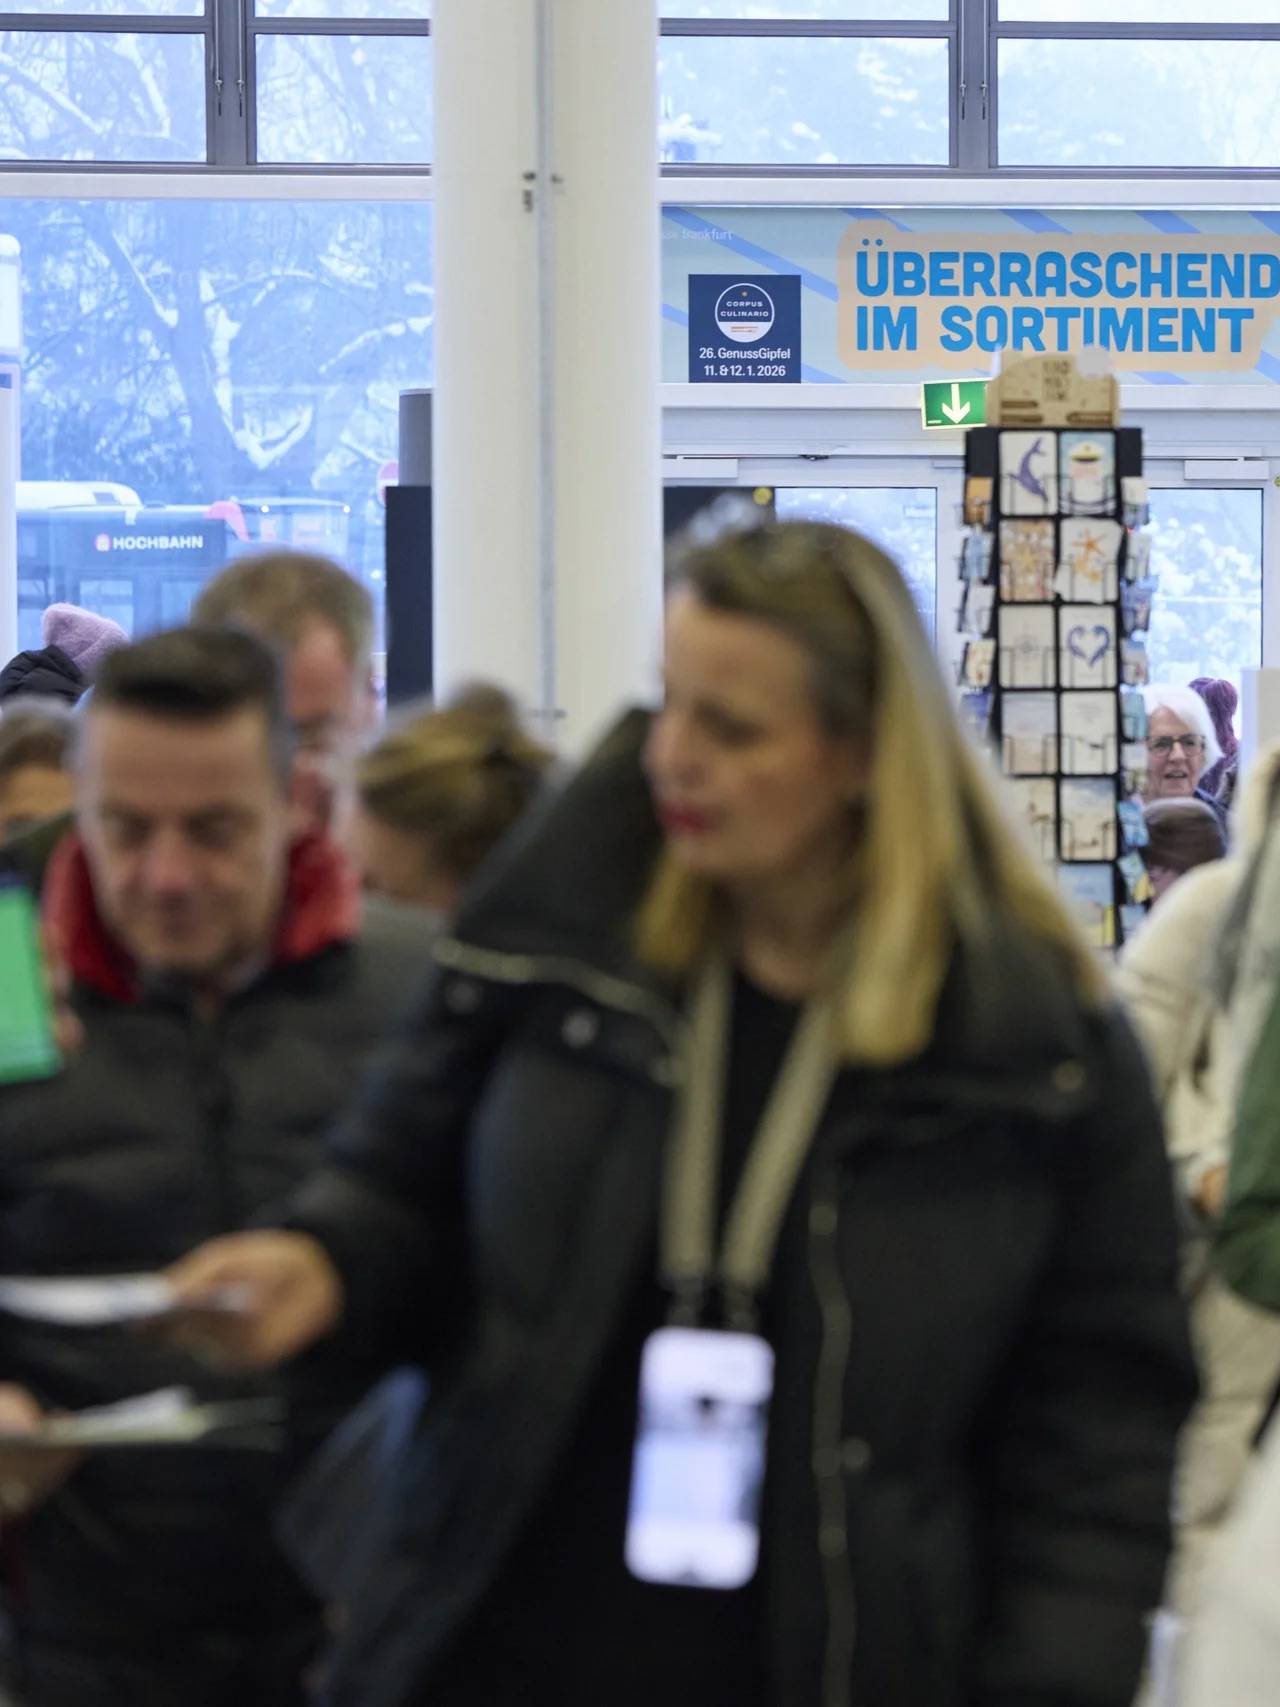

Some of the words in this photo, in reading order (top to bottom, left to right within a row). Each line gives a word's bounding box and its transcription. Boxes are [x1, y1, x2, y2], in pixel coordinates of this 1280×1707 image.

[856, 306, 917, 351] IM
[940, 305, 1254, 353] SORTIMENT
[113, 536, 204, 550] HOCHBAHN
